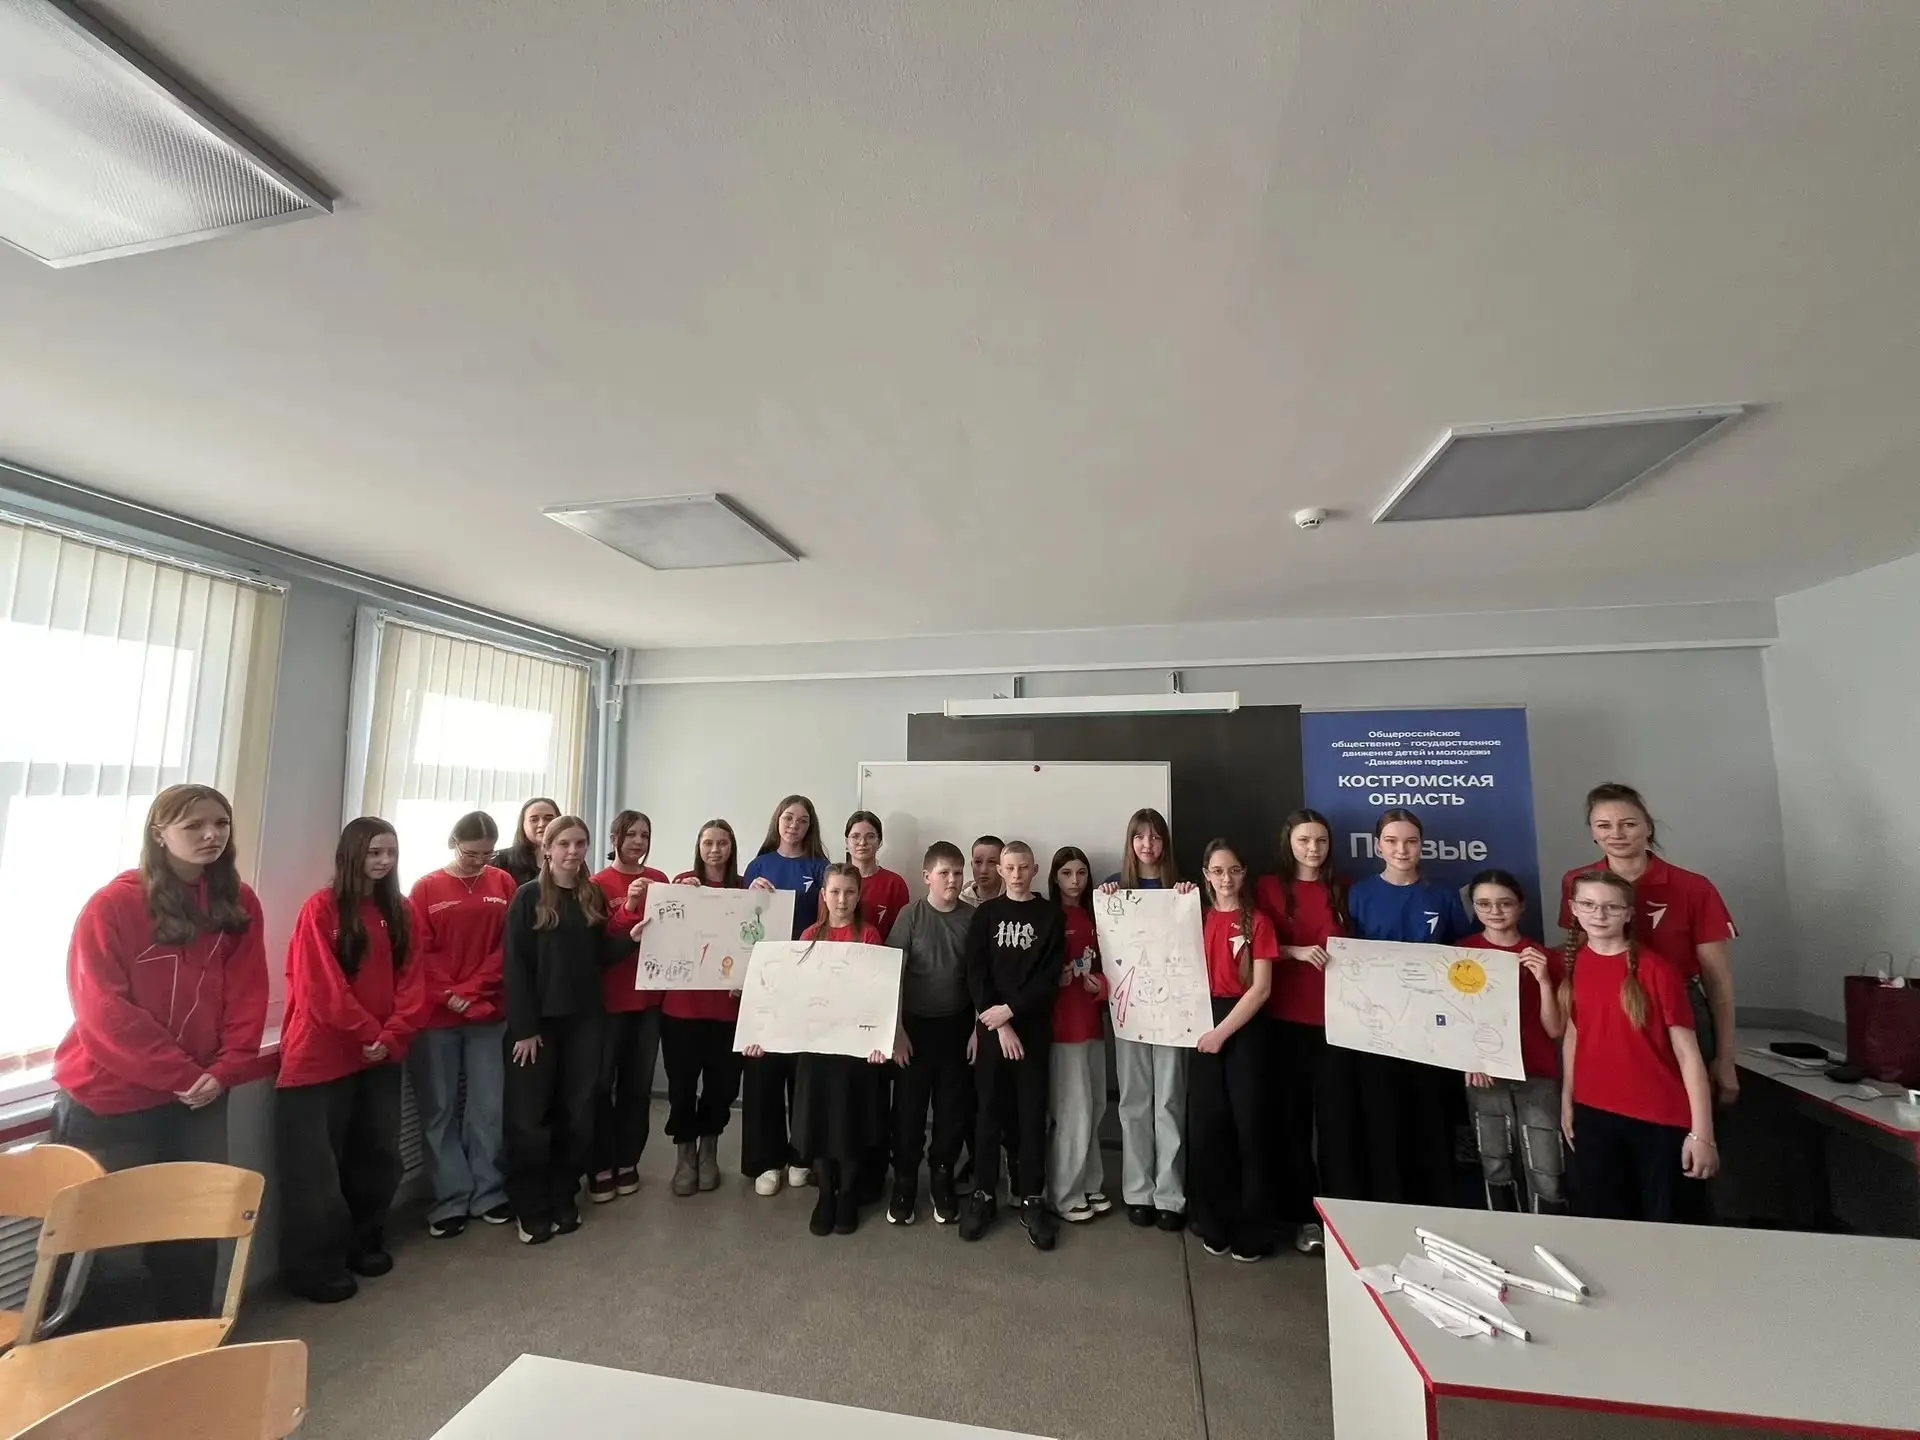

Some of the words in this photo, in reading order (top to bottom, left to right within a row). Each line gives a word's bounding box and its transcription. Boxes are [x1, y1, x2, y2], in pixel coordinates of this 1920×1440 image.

[1368, 730, 1461, 739] Общероссийское
[1331, 740, 1401, 749] общественно
[1410, 739, 1502, 748] государственное
[1395, 748, 1426, 757] детей
[1436, 749, 1491, 757] молодежи
[1338, 775, 1494, 788] КОСТРОМСКАЯ
[1368, 793, 1466, 806] ОБЛАСТЬ
[1350, 832, 1488, 861] Пвые
